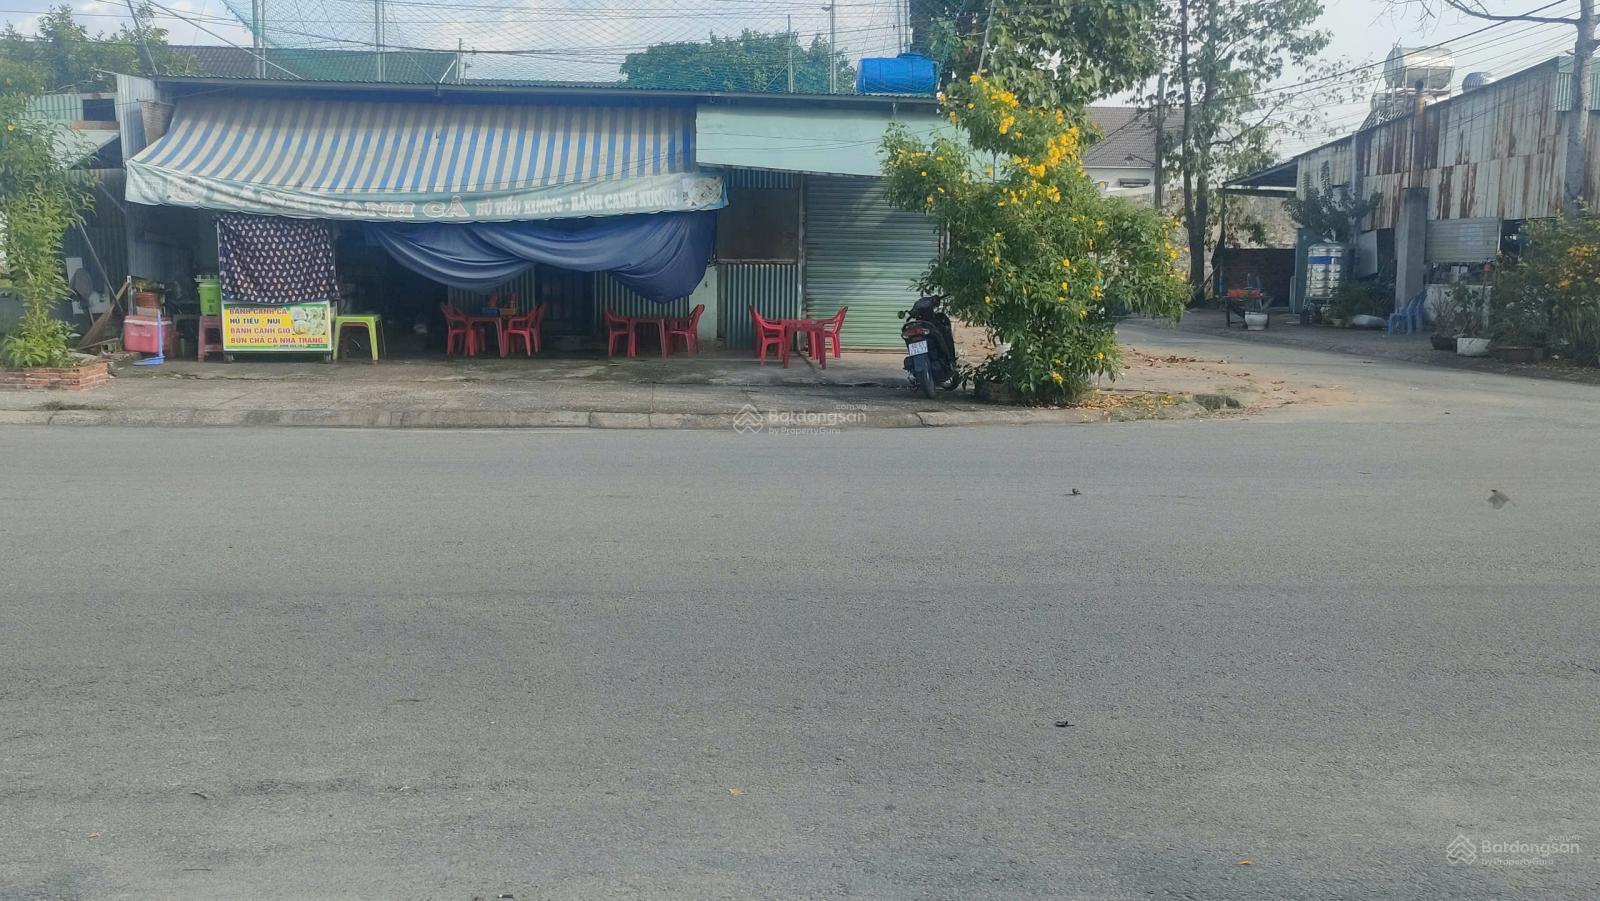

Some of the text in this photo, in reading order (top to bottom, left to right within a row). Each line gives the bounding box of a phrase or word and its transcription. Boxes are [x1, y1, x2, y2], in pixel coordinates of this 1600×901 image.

[571, 192, 603, 211] BÁNH
[605, 192, 638, 210] CANH
[280, 336, 296, 344] NHA
